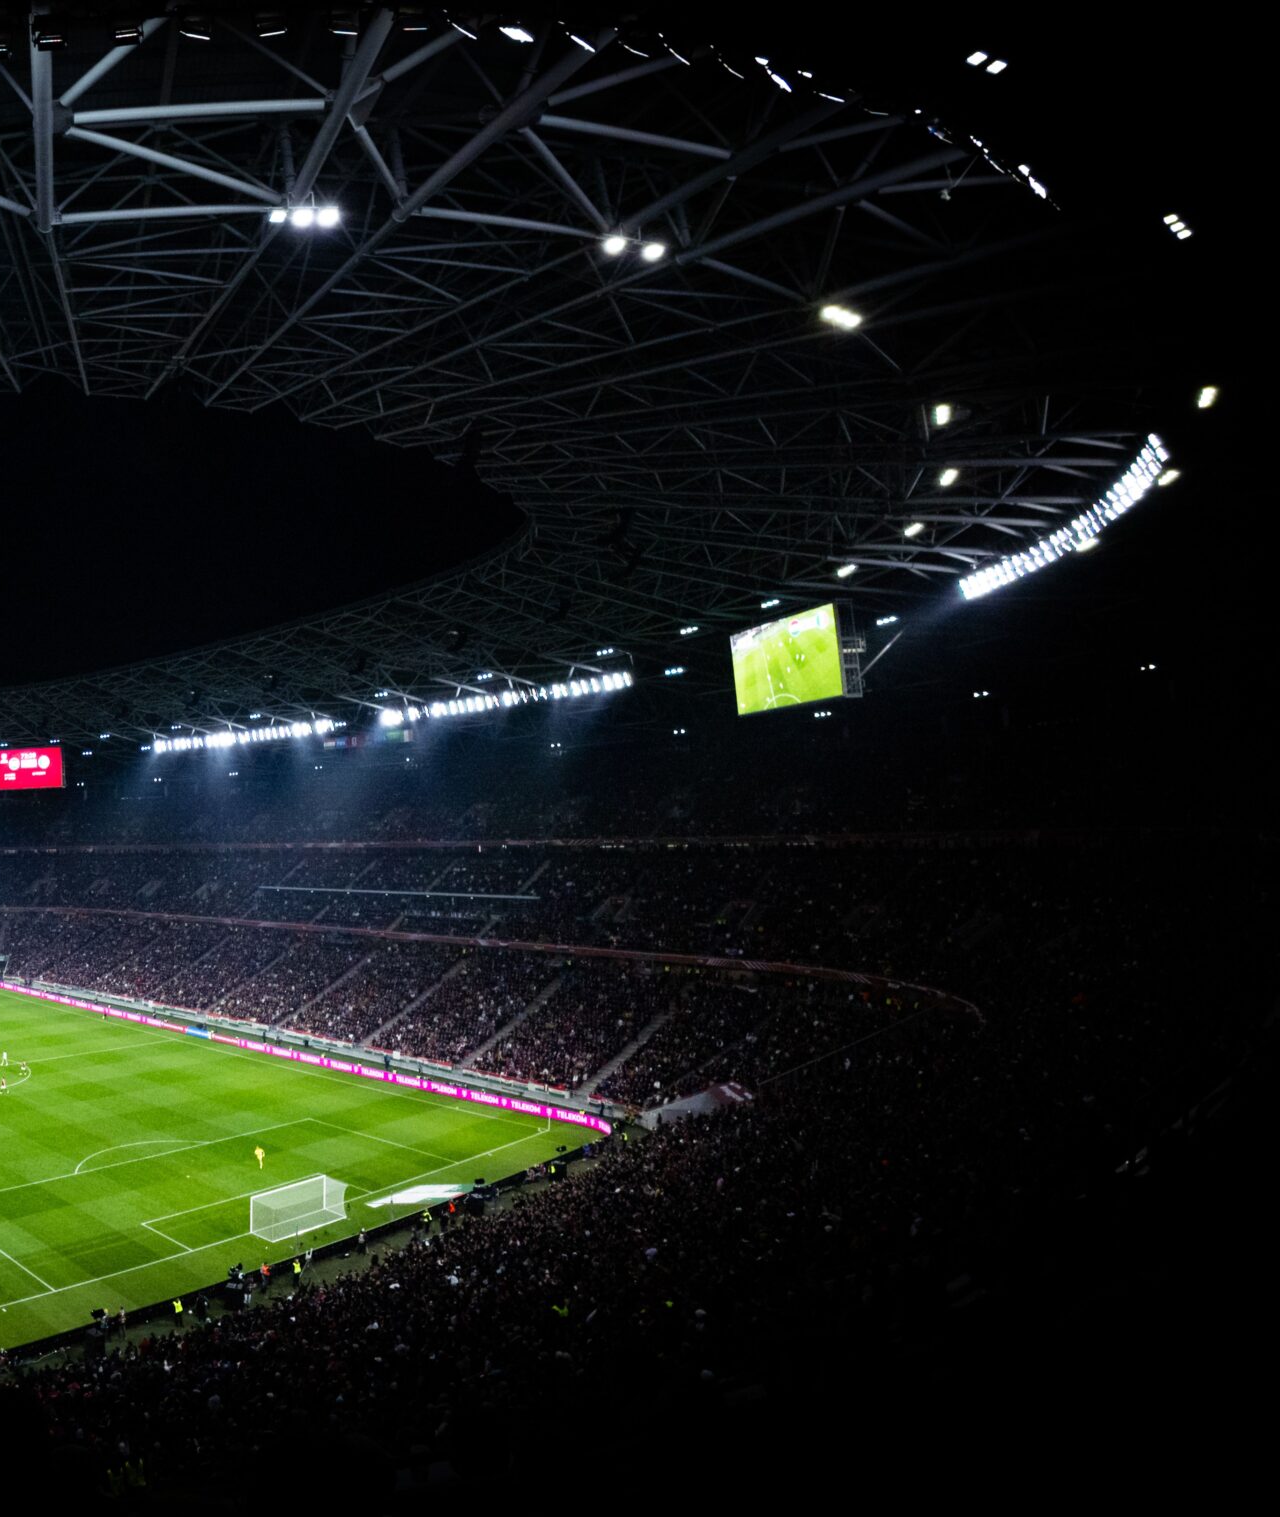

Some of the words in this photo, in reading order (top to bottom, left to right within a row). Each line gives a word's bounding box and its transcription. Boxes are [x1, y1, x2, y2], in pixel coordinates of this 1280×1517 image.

[470, 1091, 499, 1105] TELEKOM
[511, 1100, 541, 1114] TELEKOM
[556, 1110, 587, 1124] TELEKOM
